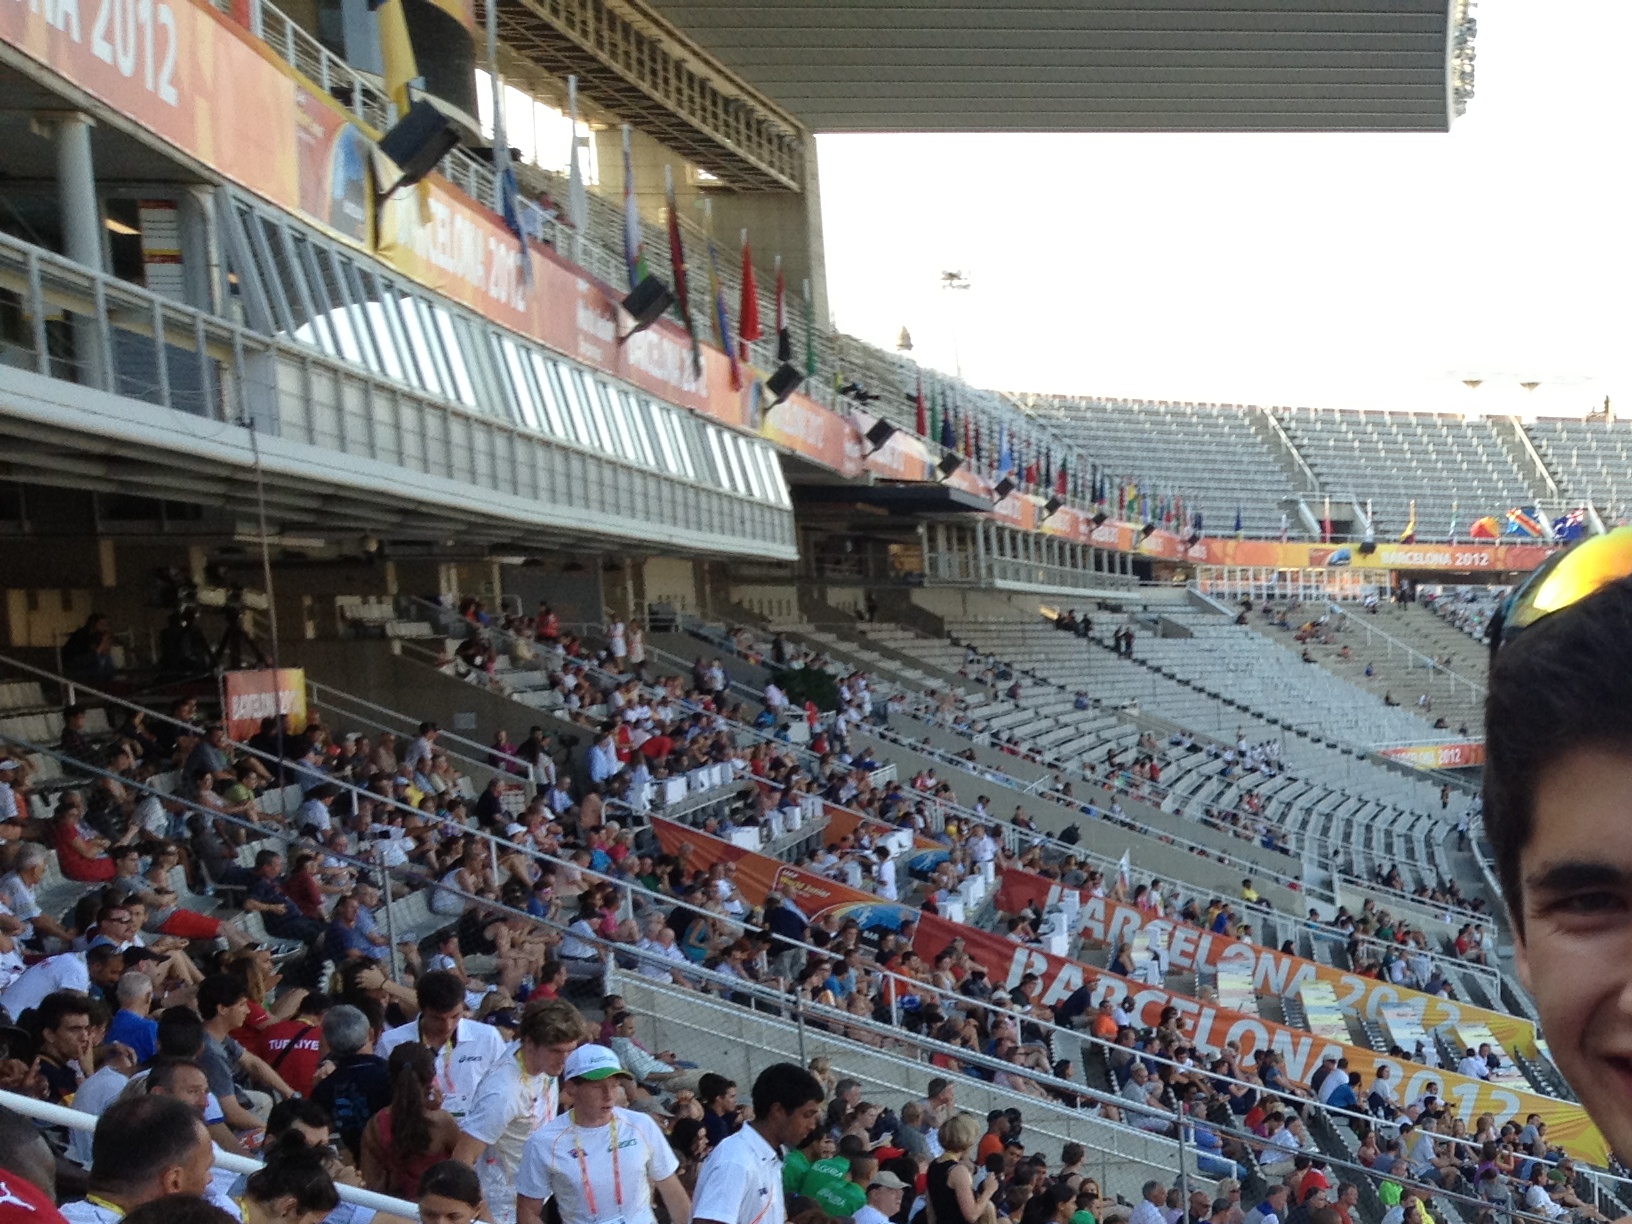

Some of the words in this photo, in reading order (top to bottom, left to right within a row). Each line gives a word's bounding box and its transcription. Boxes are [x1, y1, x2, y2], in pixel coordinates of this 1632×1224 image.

[90, 0, 179, 107] 2012
[1455, 552, 1489, 566] 2012
[1043, 884, 1317, 999] ARELONA
